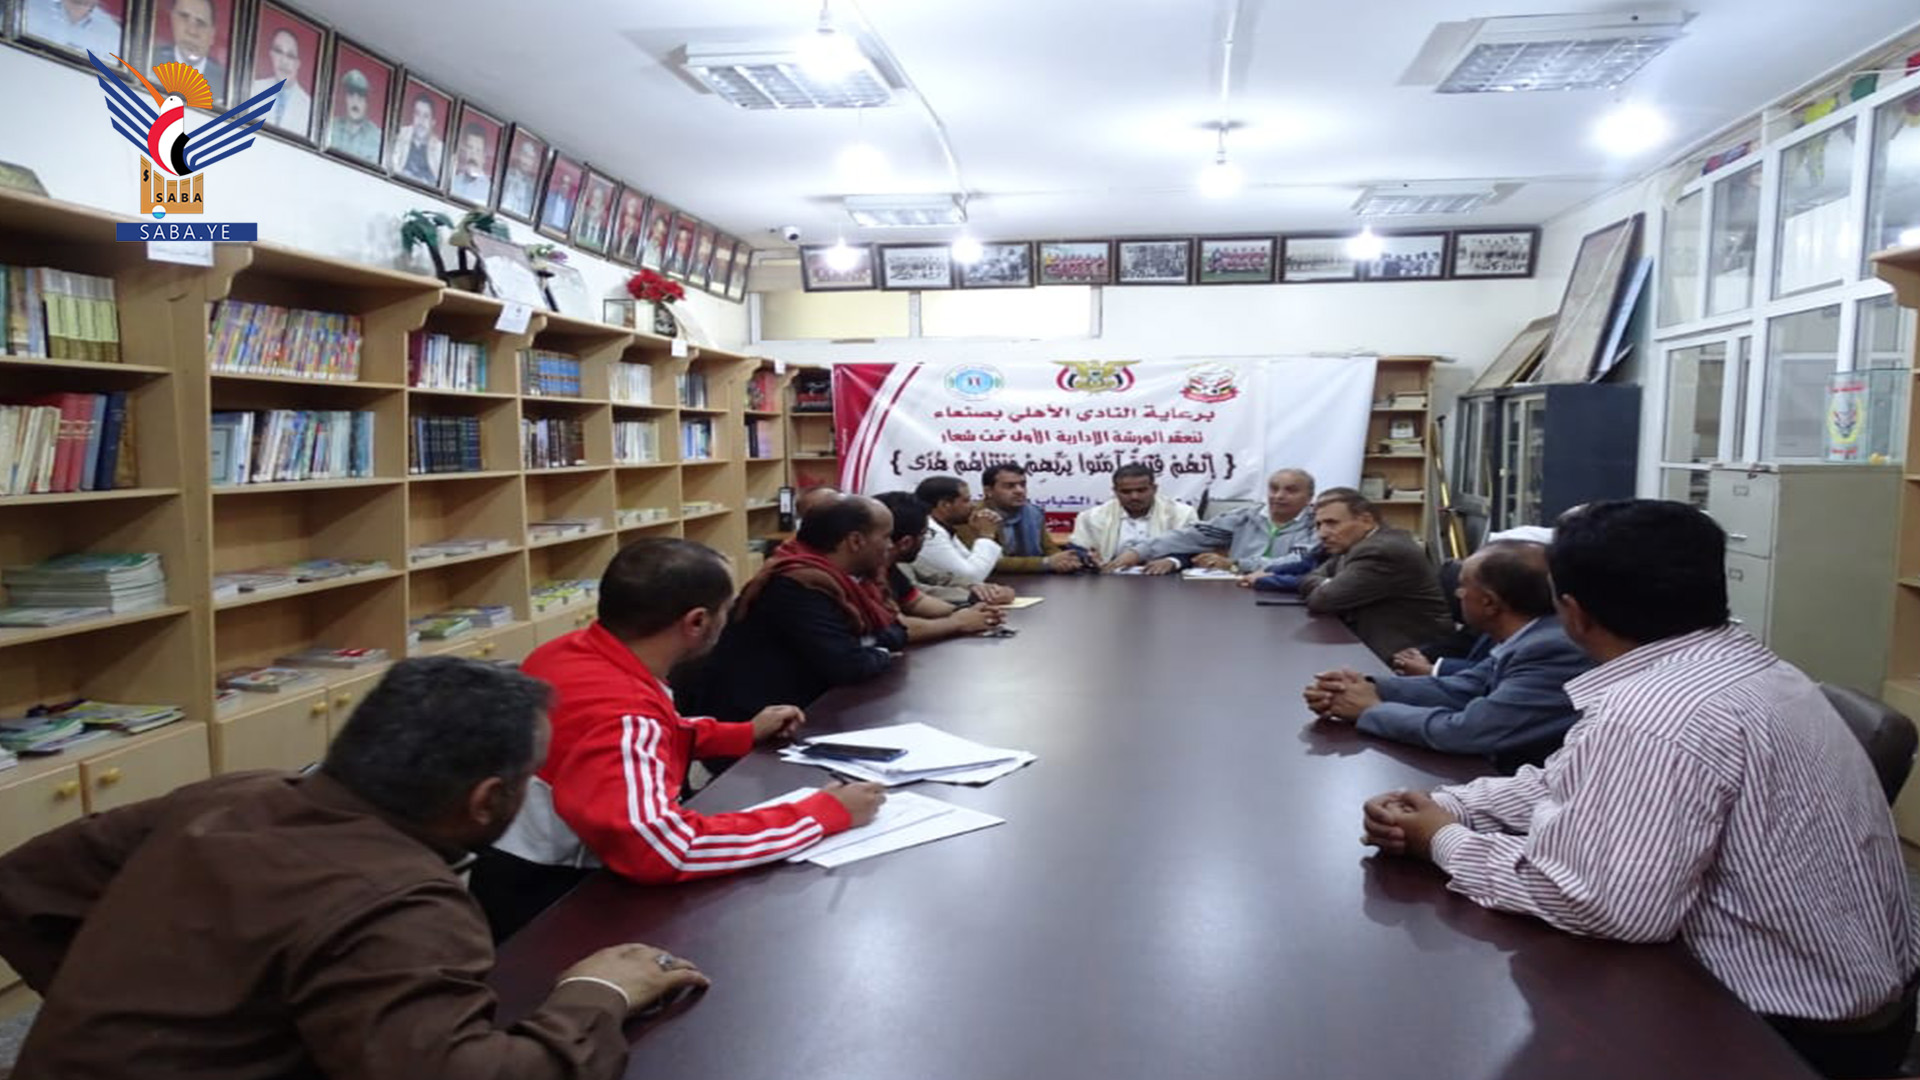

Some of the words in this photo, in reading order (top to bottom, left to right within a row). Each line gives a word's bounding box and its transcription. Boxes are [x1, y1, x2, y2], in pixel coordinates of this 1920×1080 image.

[933, 405, 1003, 421] بصنعاء
[1007, 404, 1070, 423] الأهلي
[1076, 406, 1136, 422] النادي
[1142, 404, 1215, 423] برعاية
[941, 428, 977, 443] شعار
[1112, 430, 1164, 445] الورشة
